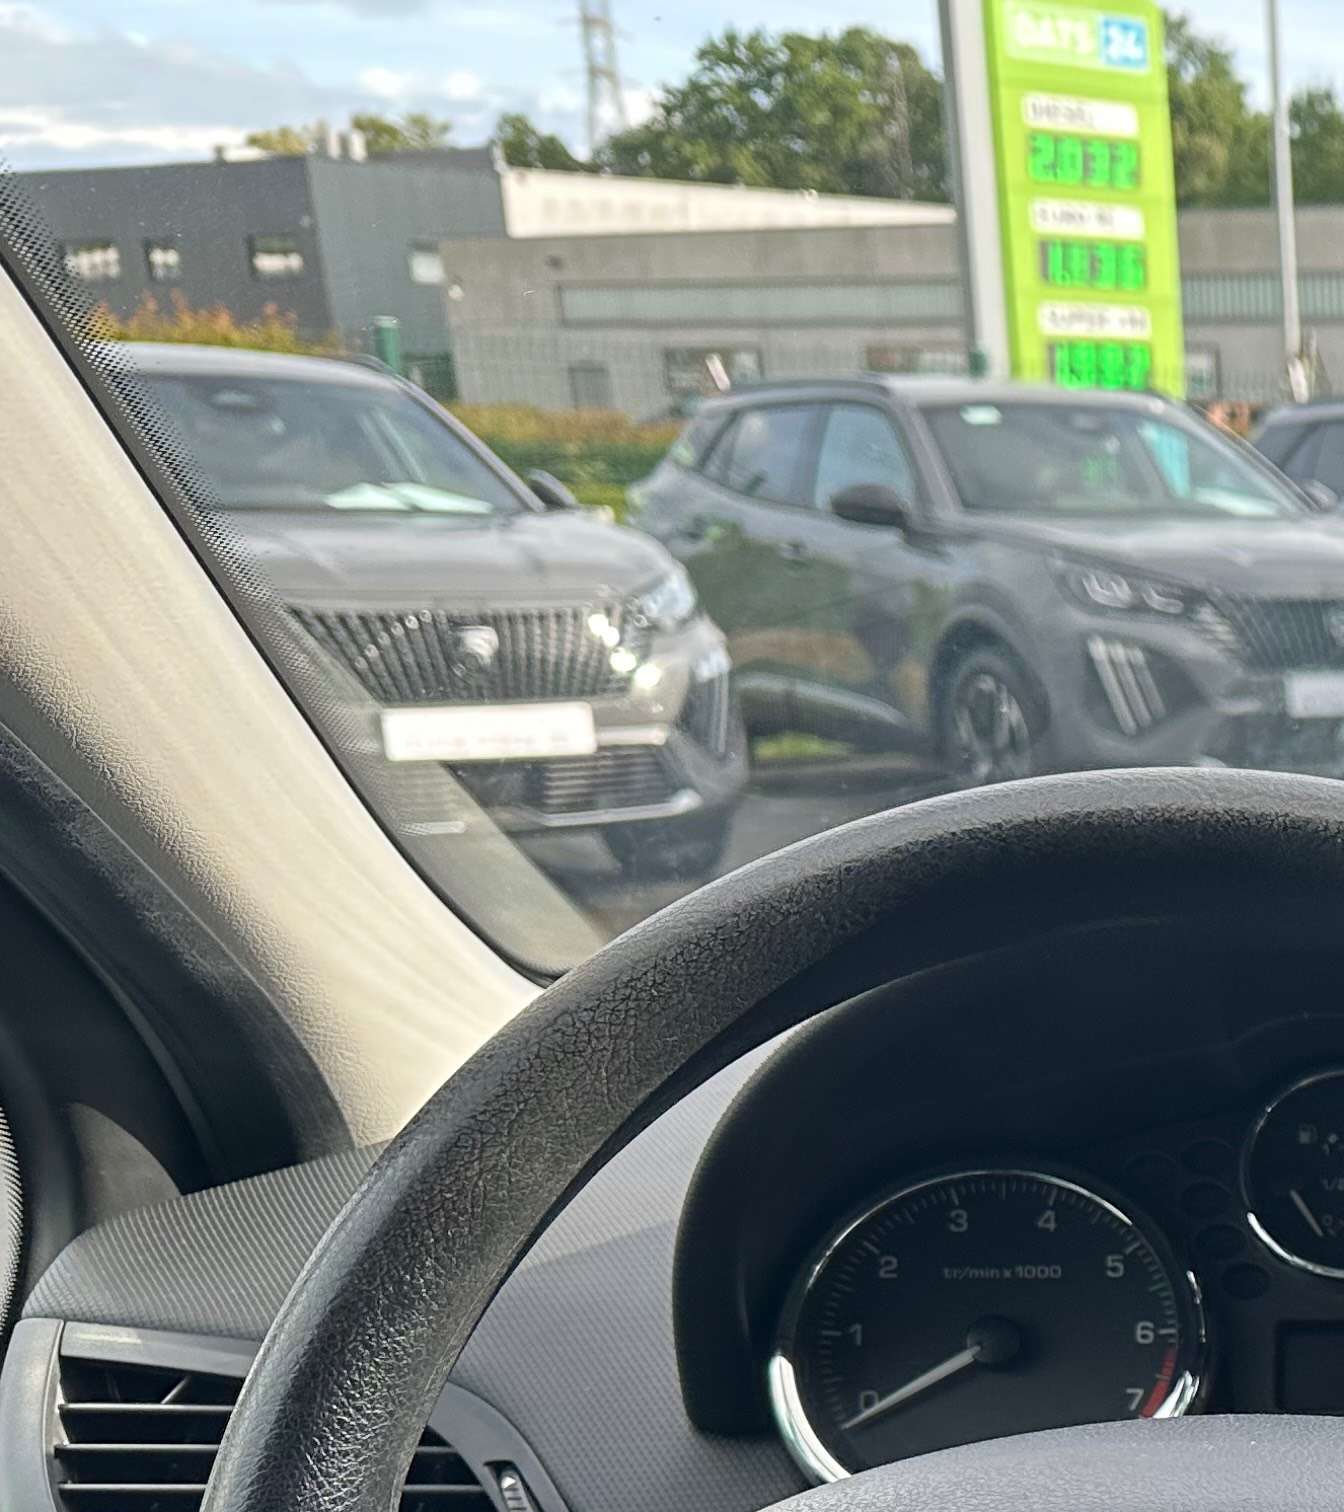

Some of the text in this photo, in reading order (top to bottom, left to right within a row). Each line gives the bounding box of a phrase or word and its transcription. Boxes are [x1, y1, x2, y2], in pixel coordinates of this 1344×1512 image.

[949, 1210, 969, 1232] 3
[1037, 1210, 1057, 1232] 4
[879, 1255, 898, 1278] 2
[943, 1264, 1000, 1280] tr/min
[1106, 1255, 1125, 1278] 5
[850, 1324, 862, 1345] 1
[1135, 1322, 1154, 1344] 6
[1126, 1388, 1144, 1409] 7
